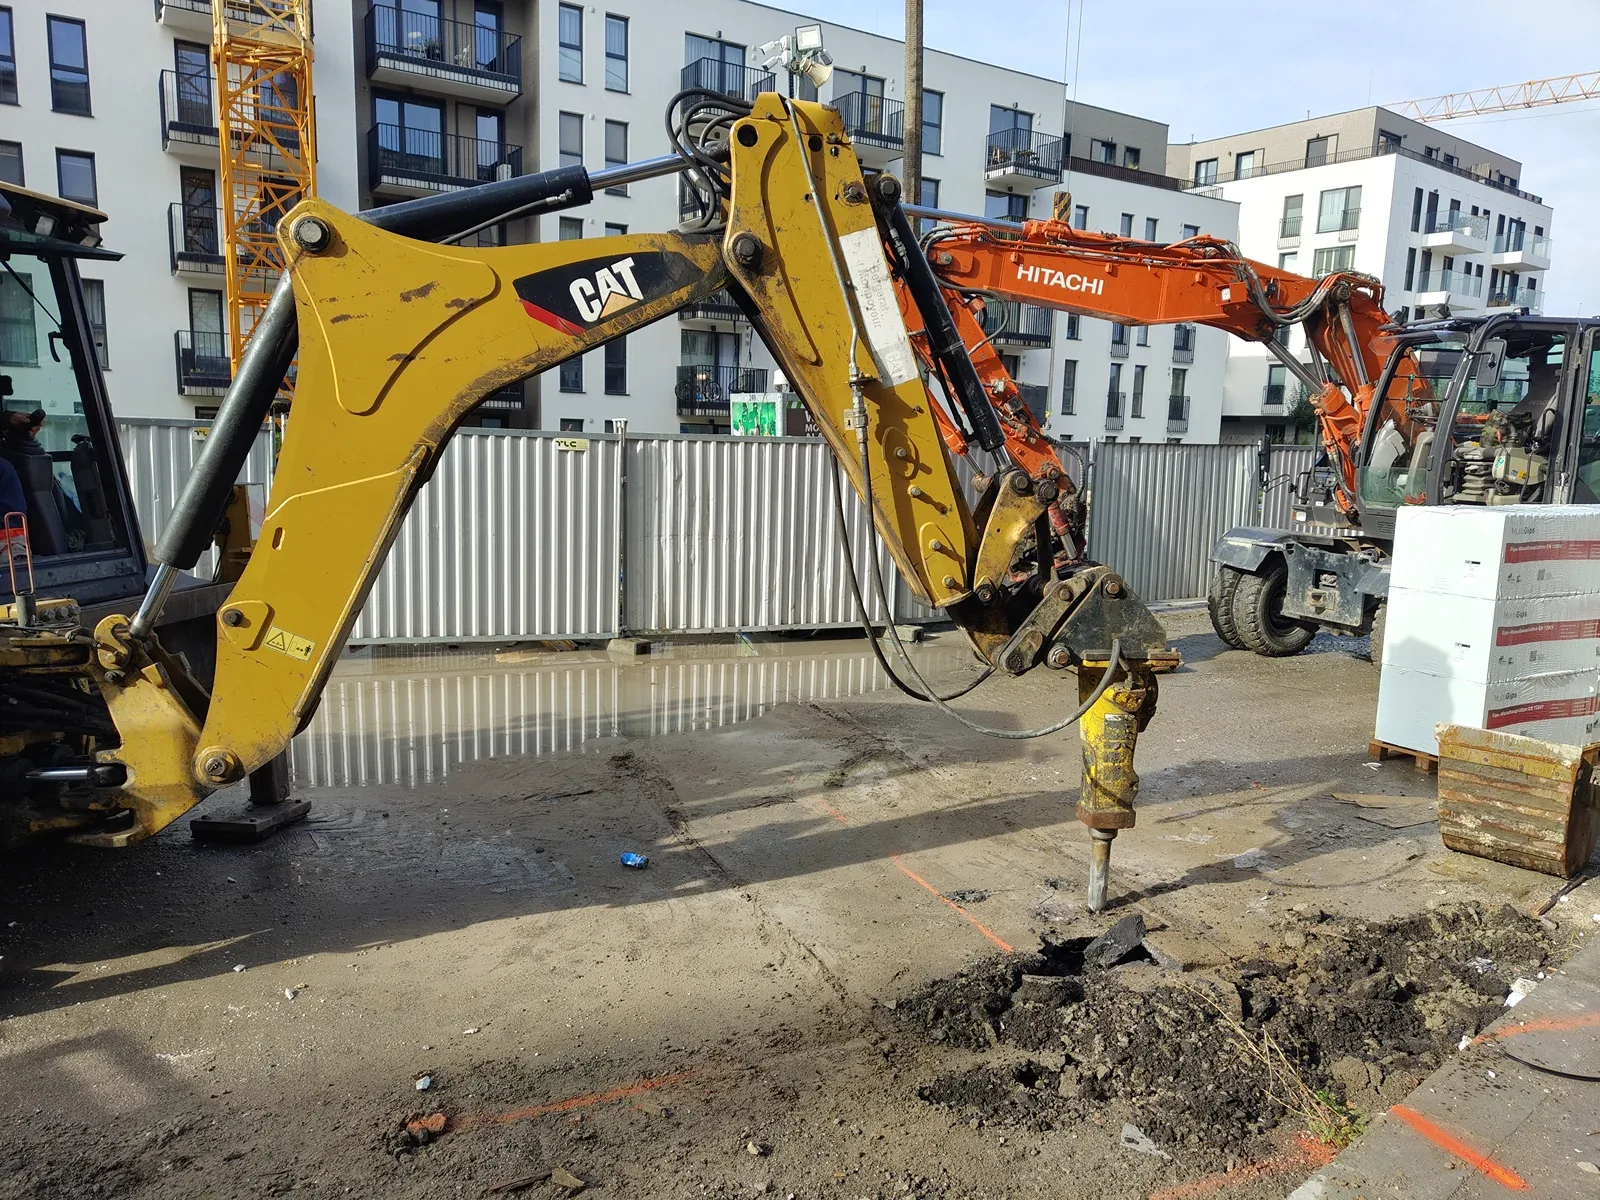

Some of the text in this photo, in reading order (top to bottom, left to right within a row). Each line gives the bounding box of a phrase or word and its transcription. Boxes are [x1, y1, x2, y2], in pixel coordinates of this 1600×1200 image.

[568, 256, 644, 323] CAT
[1016, 264, 1104, 295] HITACHI
[555, 440, 577, 448] TLC
